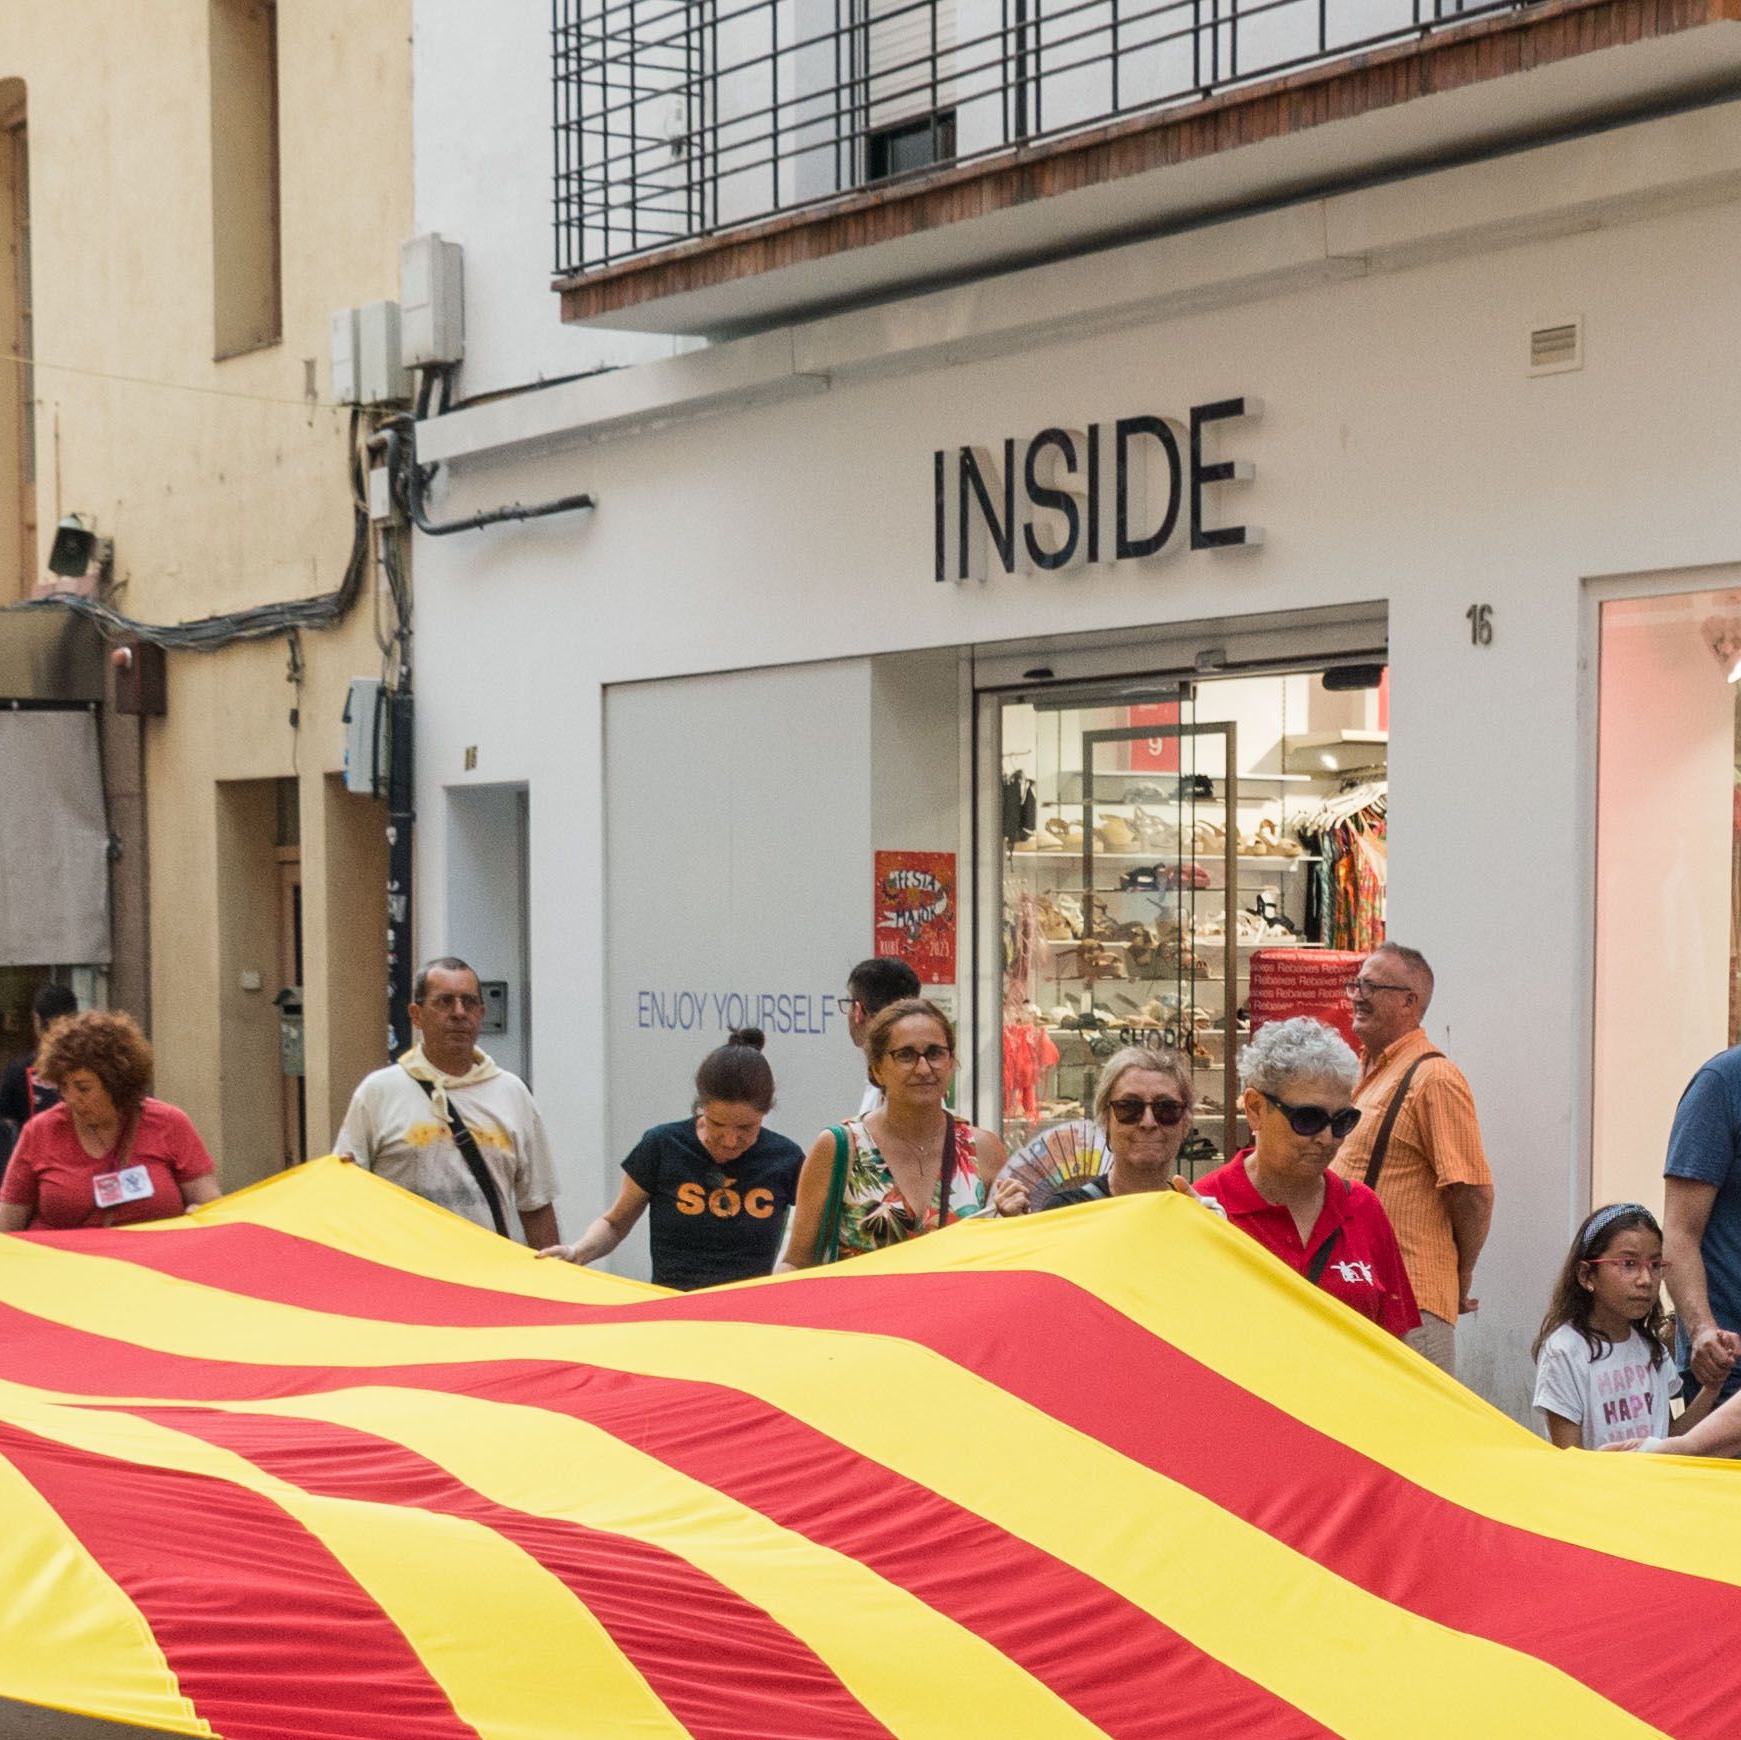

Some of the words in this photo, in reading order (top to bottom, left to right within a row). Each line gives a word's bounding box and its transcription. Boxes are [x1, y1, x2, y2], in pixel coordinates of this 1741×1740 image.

[934, 397, 1246, 582] INSIDE
[1466, 603, 1493, 646] 16
[638, 991, 708, 1030] ENJOY
[713, 992, 836, 1035] YOURSELF
